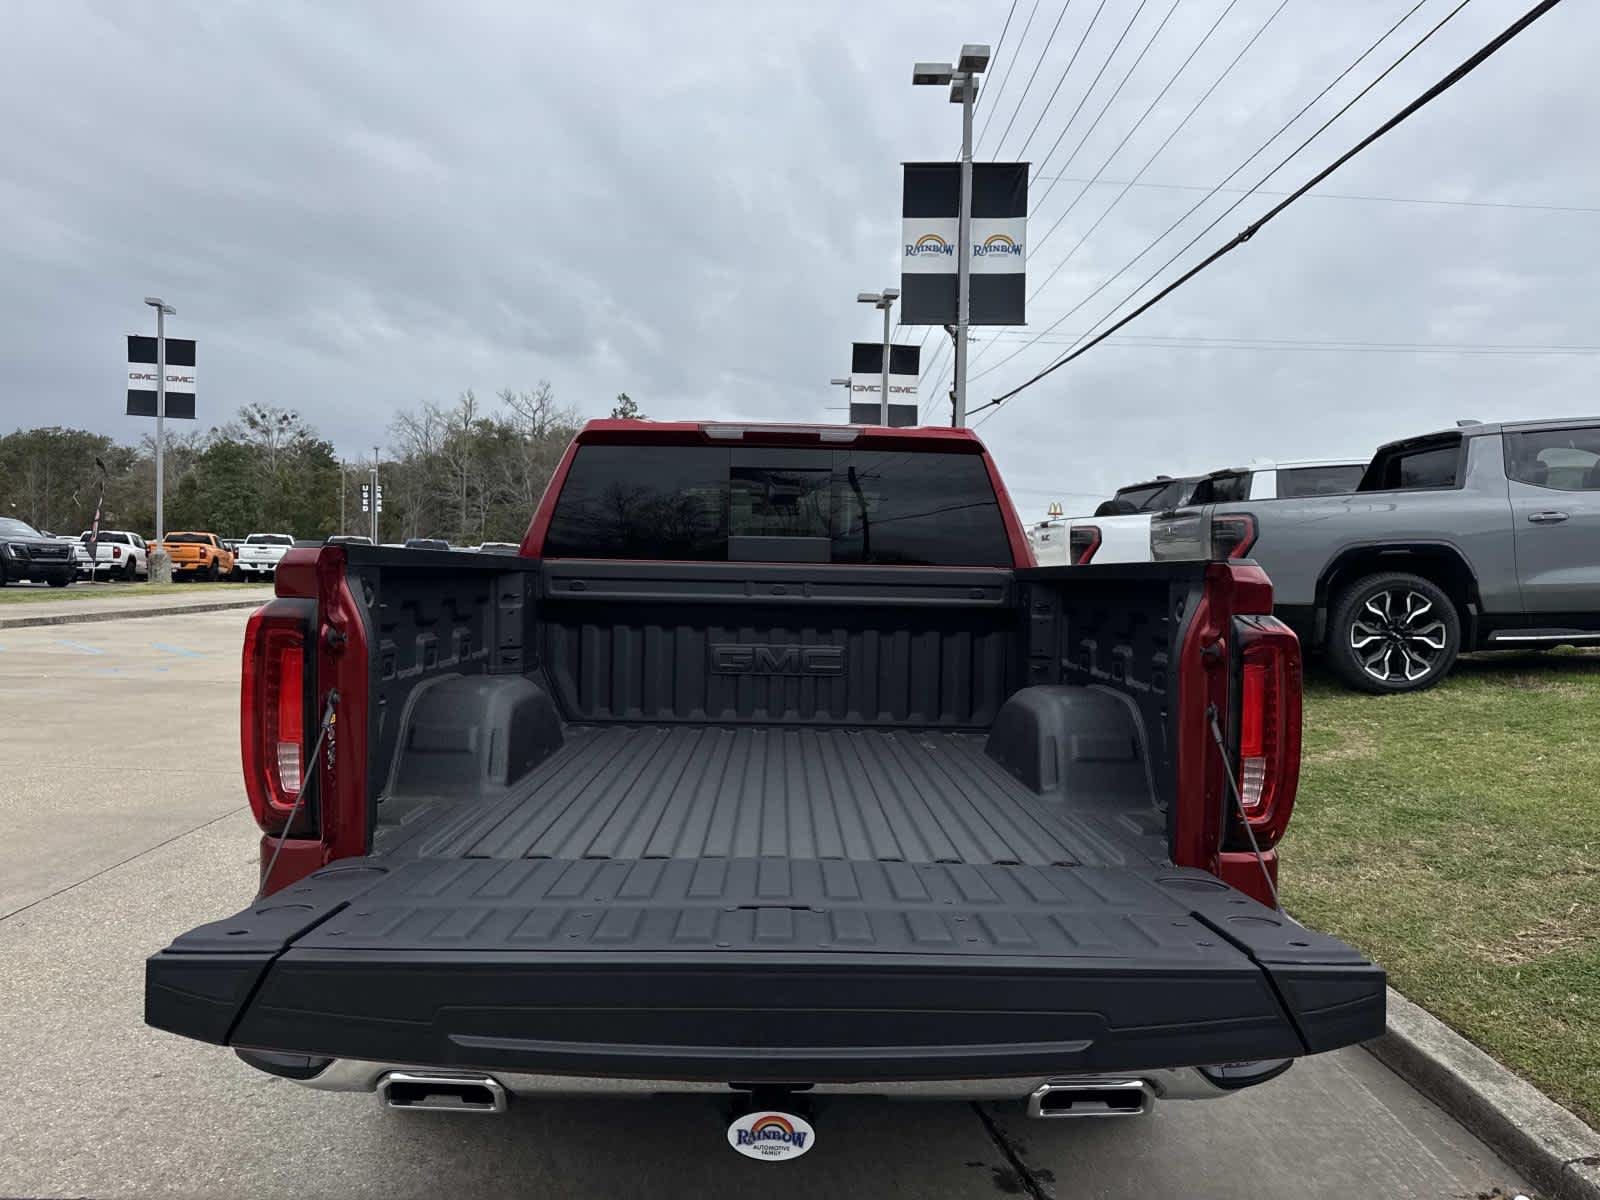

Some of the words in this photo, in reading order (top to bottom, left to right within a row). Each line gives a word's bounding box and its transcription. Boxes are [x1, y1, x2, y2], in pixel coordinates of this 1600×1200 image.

[905, 244, 954, 257] RAINBOW
[973, 244, 1023, 257] RAINBOW
[129, 373, 158, 381] GMC
[166, 375, 195, 384] GMC
[889, 386, 918, 394] GMC
[711, 645, 842, 675] GMC
[736, 1128, 808, 1148] RAINBOW
[753, 1144, 790, 1152] AUTOMOTIVE
